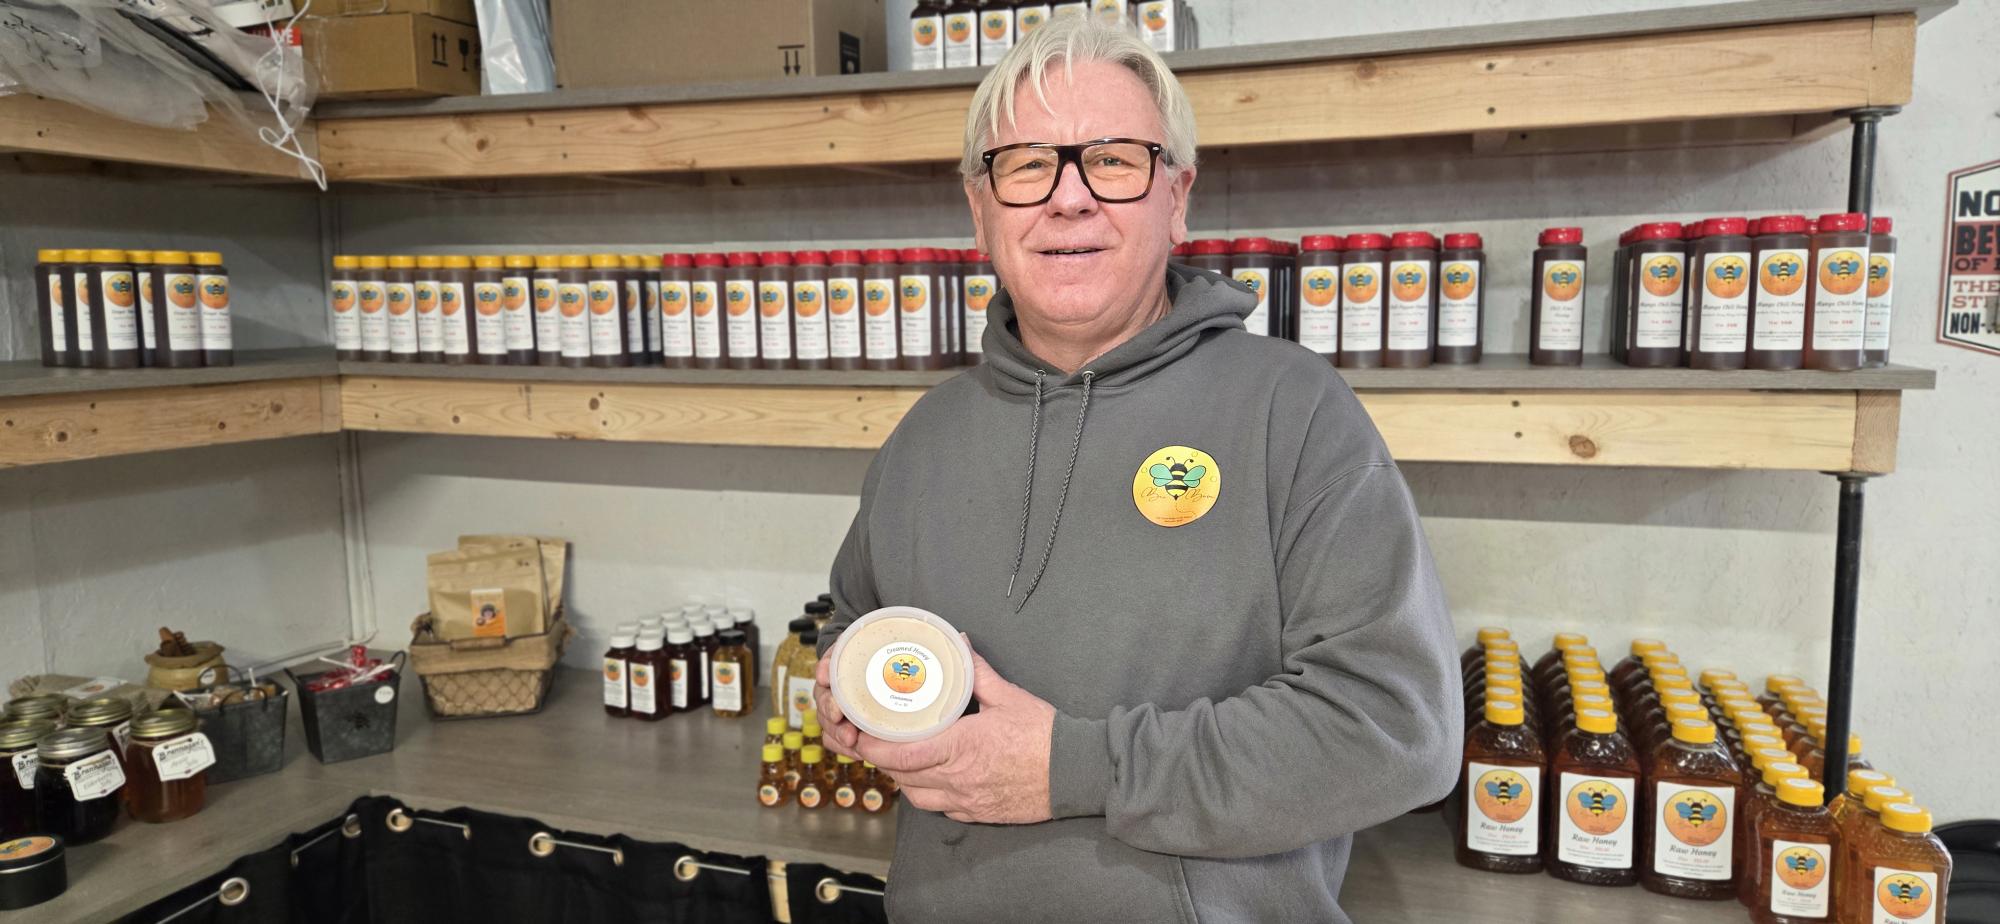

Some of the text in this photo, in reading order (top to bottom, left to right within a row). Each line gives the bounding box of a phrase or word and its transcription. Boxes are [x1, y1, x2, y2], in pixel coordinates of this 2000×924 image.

[1955, 257, 1988, 271] OF
[1950, 312, 2000, 334] NON-
[886, 646, 930, 661] Creamed Honey
[1480, 821, 1524, 834] Raw Honey
[1571, 833, 1618, 848] Raw Honey
[1668, 844, 1718, 859] Raw Honey
